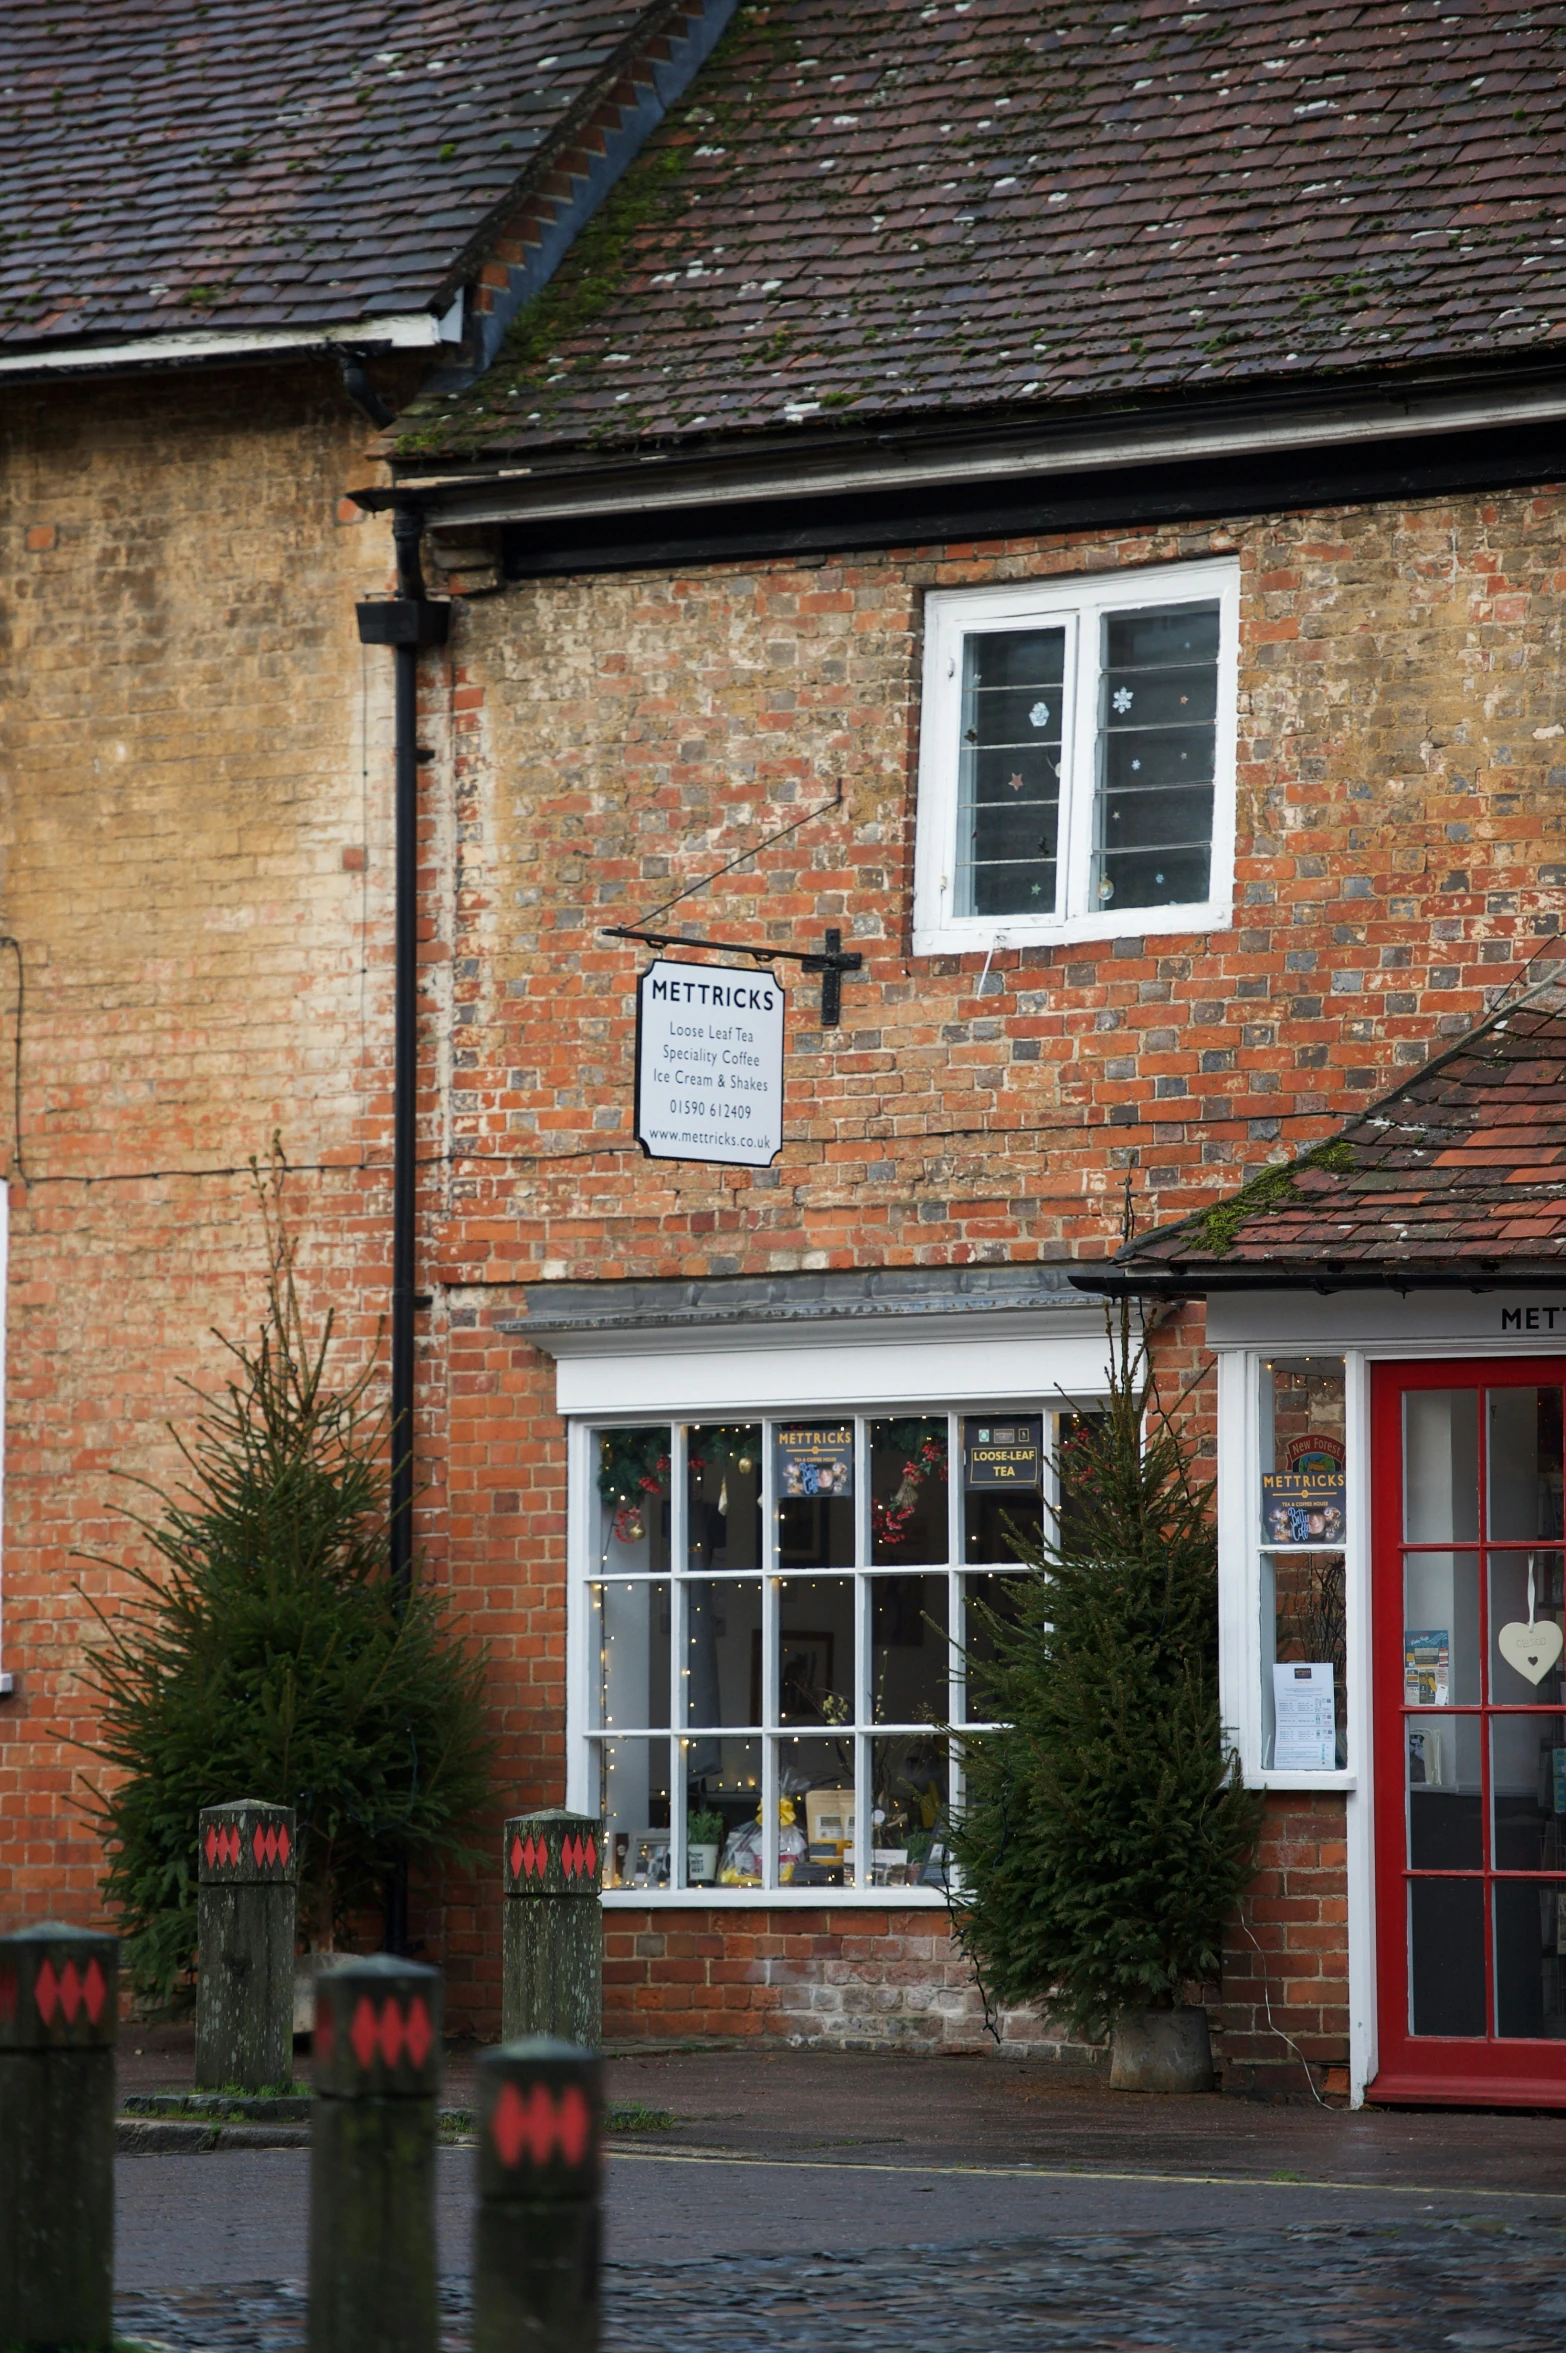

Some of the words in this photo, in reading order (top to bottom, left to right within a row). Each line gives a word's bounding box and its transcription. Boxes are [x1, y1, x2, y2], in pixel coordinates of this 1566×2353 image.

[652, 979, 774, 1011] METTRICKS
[669, 1021, 704, 1038] Loose
[708, 1025, 734, 1040] Leaf
[735, 1027, 754, 1043] Tea
[662, 1044, 718, 1066] Speciality
[722, 1050, 760, 1067] Coffee
[653, 1068, 670, 1083] Ice
[674, 1070, 713, 1087] Cream
[717, 1074, 726, 1088] &
[730, 1075, 769, 1092] Shakes
[669, 1099, 705, 1116] 01590
[709, 1102, 752, 1119] 612409
[649, 1128, 771, 1149] www.mettricks.co.uk
[1502, 1307, 1566, 1330] MET
[779, 1432, 851, 1444] METTRICKS
[1292, 1439, 1311, 1456] New
[1313, 1437, 1342, 1457] Forest
[973, 1450, 1035, 1462] LOOSE-LEAF
[993, 1466, 1015, 1477] TEA
[1263, 1474, 1345, 1488] METTRICKS
